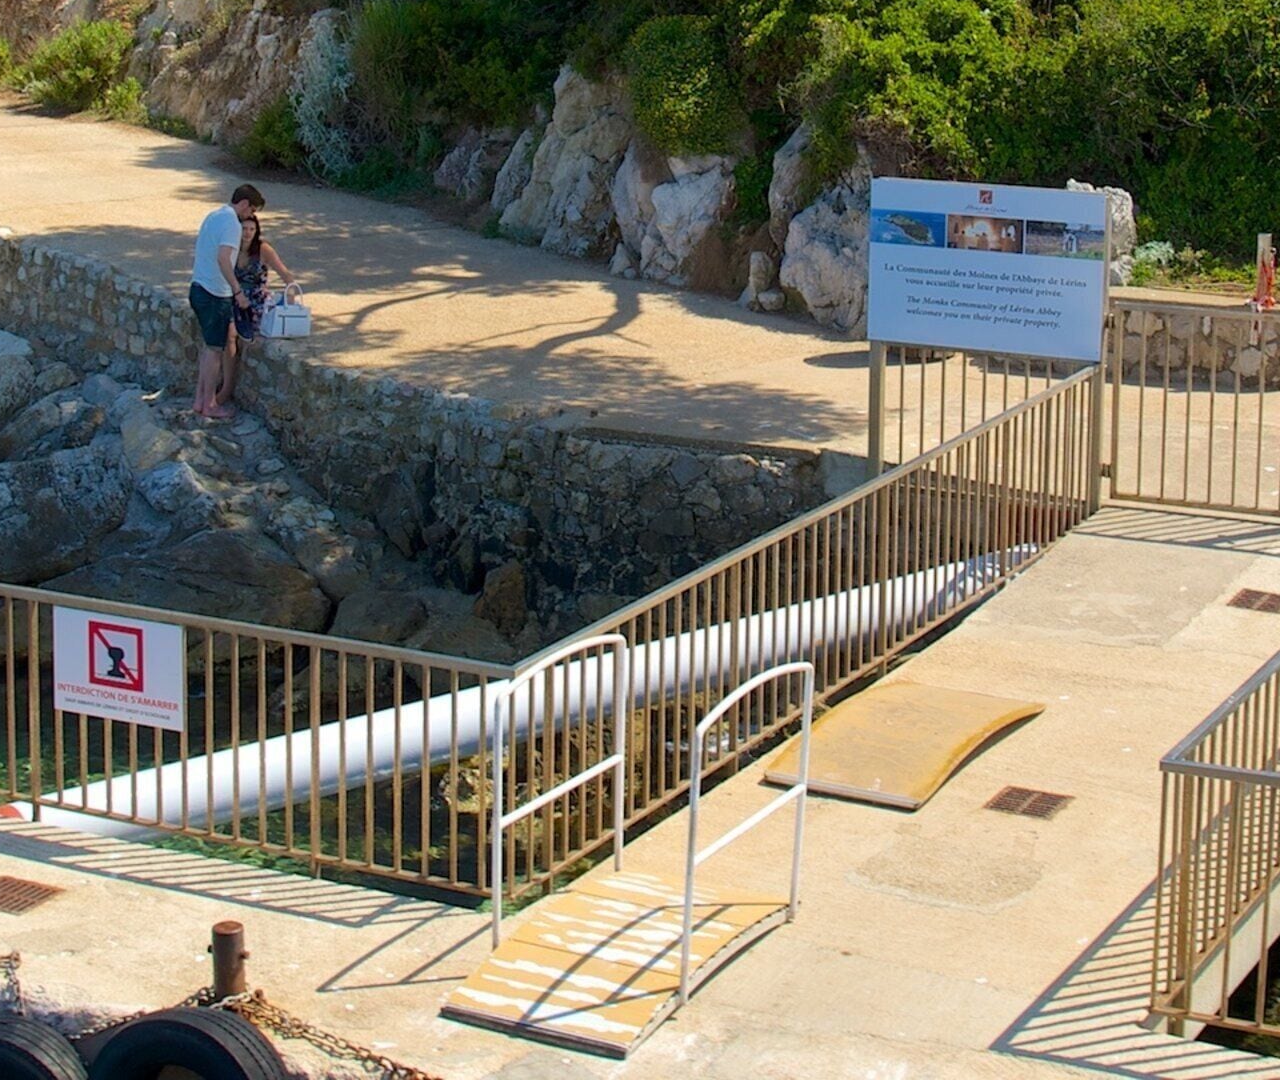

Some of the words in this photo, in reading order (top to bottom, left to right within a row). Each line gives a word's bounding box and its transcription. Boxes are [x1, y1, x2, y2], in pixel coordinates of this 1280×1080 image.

[884, 263, 894, 271] La
[896, 264, 951, 276] Communauté
[953, 268, 966, 277] des
[969, 270, 998, 280] Moines
[1000, 272, 1010, 280] de
[926, 279, 960, 288] accueille
[977, 283, 994, 291] leur
[907, 295, 920, 303] The
[922, 297, 948, 306] Monks
[950, 300, 997, 312] Community
[1036, 307, 1062, 318] Abbey
[907, 307, 942, 317] welcomes
[944, 312, 958, 320] you
[993, 316, 1022, 324] private
[57, 683, 116, 700] INTERDICTION
[118, 693, 128, 703] DE
[131, 696, 179, 712] S'AMARRER
